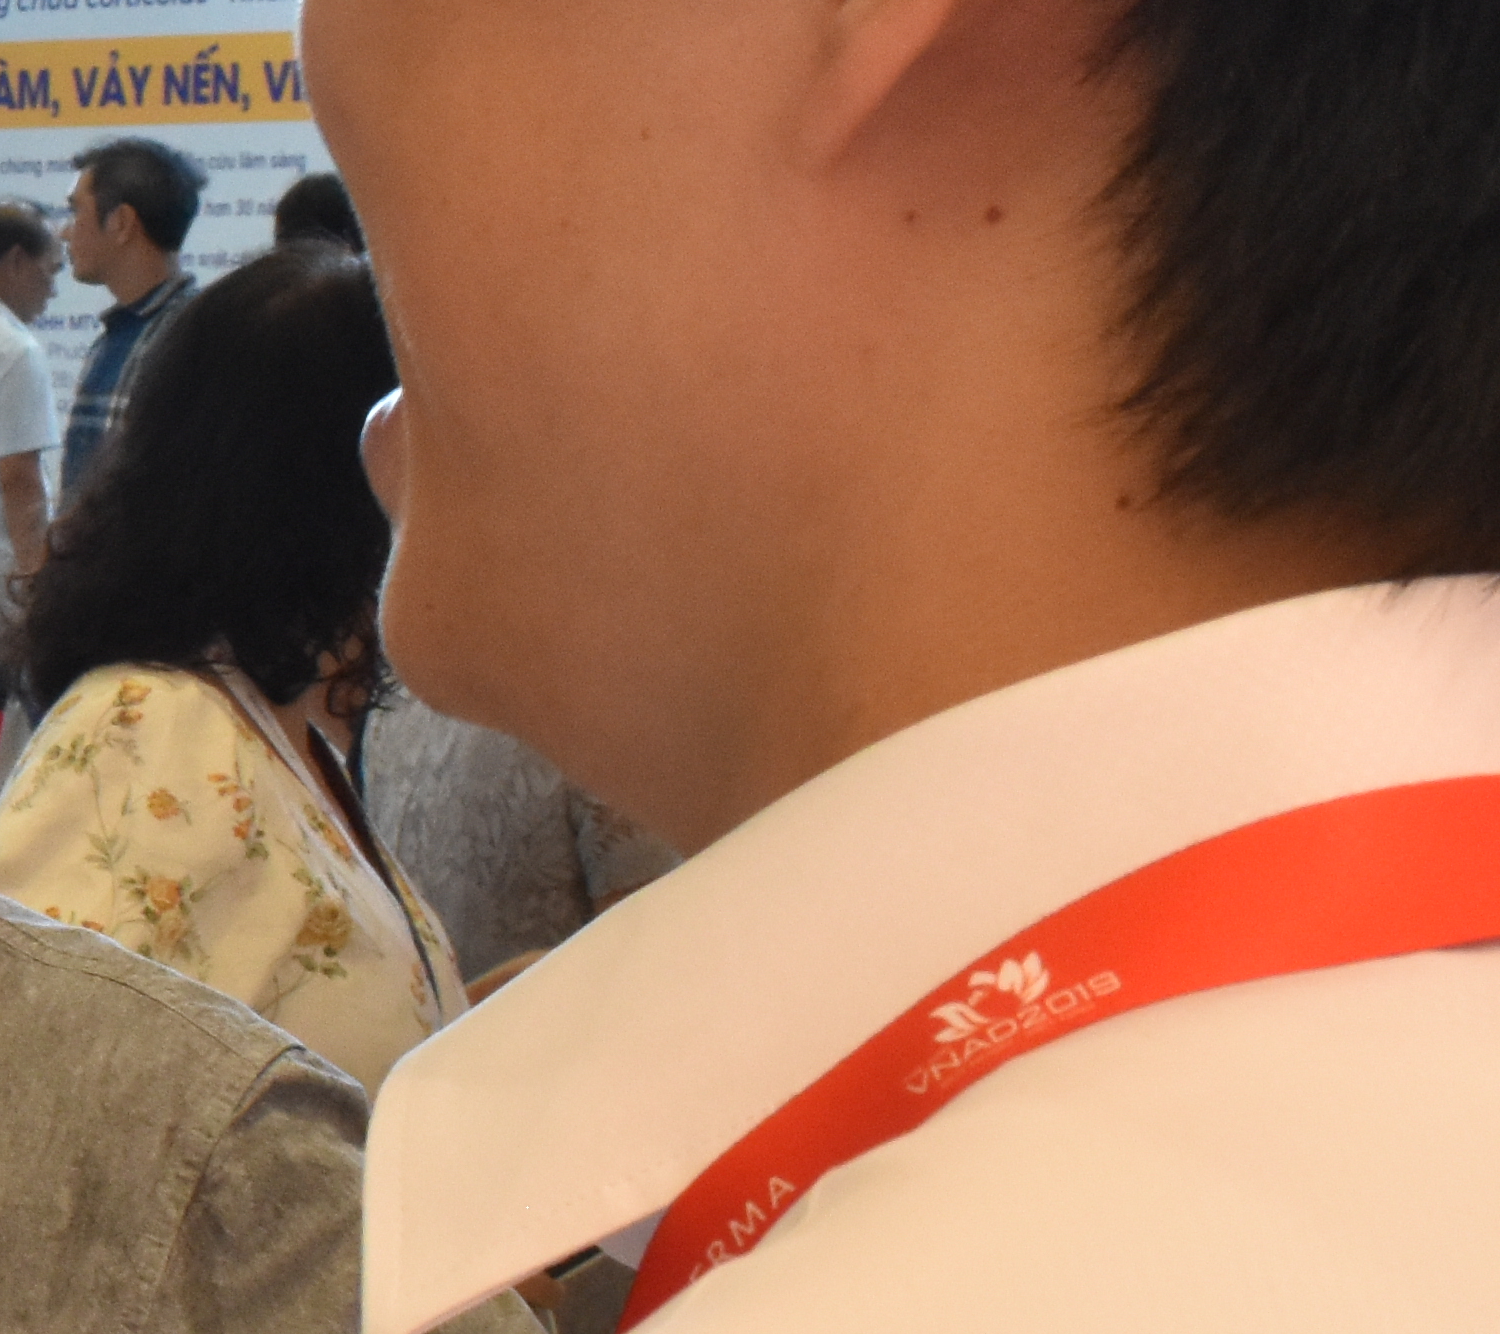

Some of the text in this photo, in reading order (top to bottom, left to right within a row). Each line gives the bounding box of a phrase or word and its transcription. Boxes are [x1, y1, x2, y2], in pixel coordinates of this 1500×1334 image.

[73, 49, 152, 108] VẢY
[163, 42, 252, 111] NẾN,
[904, 969, 1123, 1096] VNAD2019
